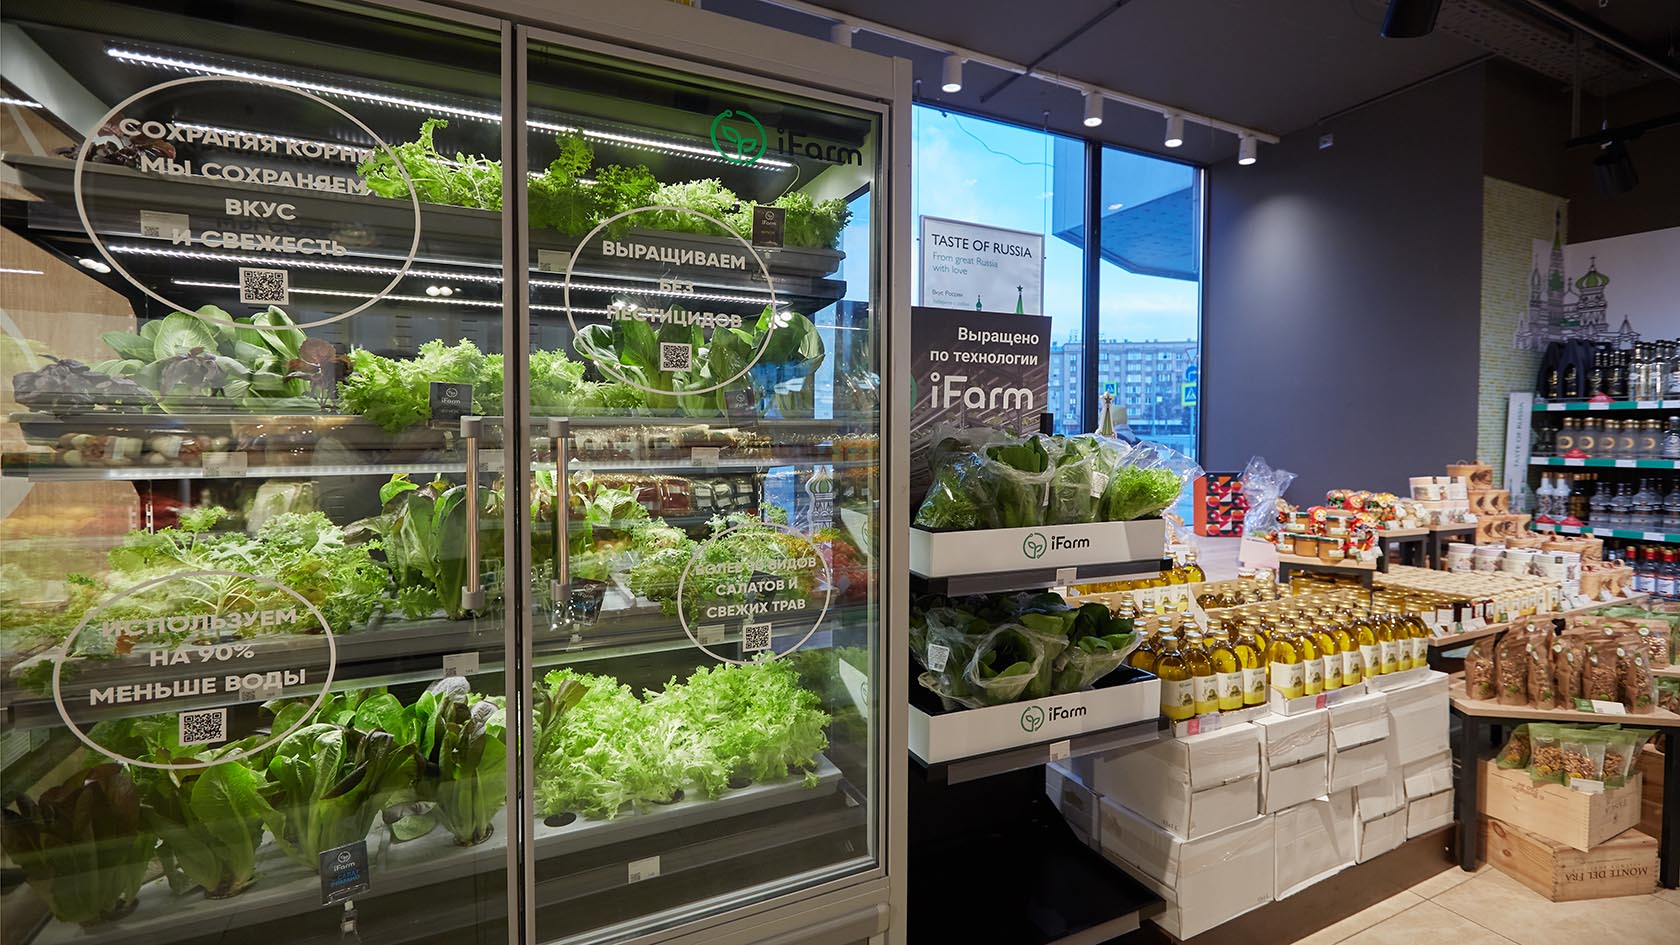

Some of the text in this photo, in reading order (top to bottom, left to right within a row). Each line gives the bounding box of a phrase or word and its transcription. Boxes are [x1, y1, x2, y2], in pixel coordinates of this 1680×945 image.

[119, 118, 374, 163] СОХРАНЯЯ КОРНИ
[778, 127, 863, 167] iFarm
[141, 155, 368, 195] МЫ СОХРАНЯЕМ
[225, 198, 296, 220] ВКУС
[172, 228, 348, 257] И СВЕЖЕСТЬ
[931, 234, 1032, 258] TASTE OF RUSSIA
[602, 240, 746, 271] ВЫРАЩИВАЕМ
[932, 252, 999, 268] From great Russia
[932, 264, 968, 275] with love
[659, 279, 694, 295] БЕЗ
[606, 304, 743, 329] ПЕСТИЦИДОВ
[958, 327, 1039, 346] Выращено
[930, 350, 1039, 366] по технологии
[930, 372, 1034, 410] iFarm
[1051, 535, 1090, 550] iFarm
[768, 557, 817, 571] ВИДОВ
[716, 577, 798, 596] САЛАТОВ И
[707, 599, 806, 618] СВЕЖИХ ТРАВ
[102, 608, 297, 637] ИСПОЛЬЗУЕМ
[150, 643, 255, 667] НА 90%
[90, 668, 306, 706] МЕНЬШЕ ВОДЫ
[1049, 705, 1087, 721] iFarm
[1588, 871, 1606, 879] DEL
[1610, 867, 1648, 877] MONTE
